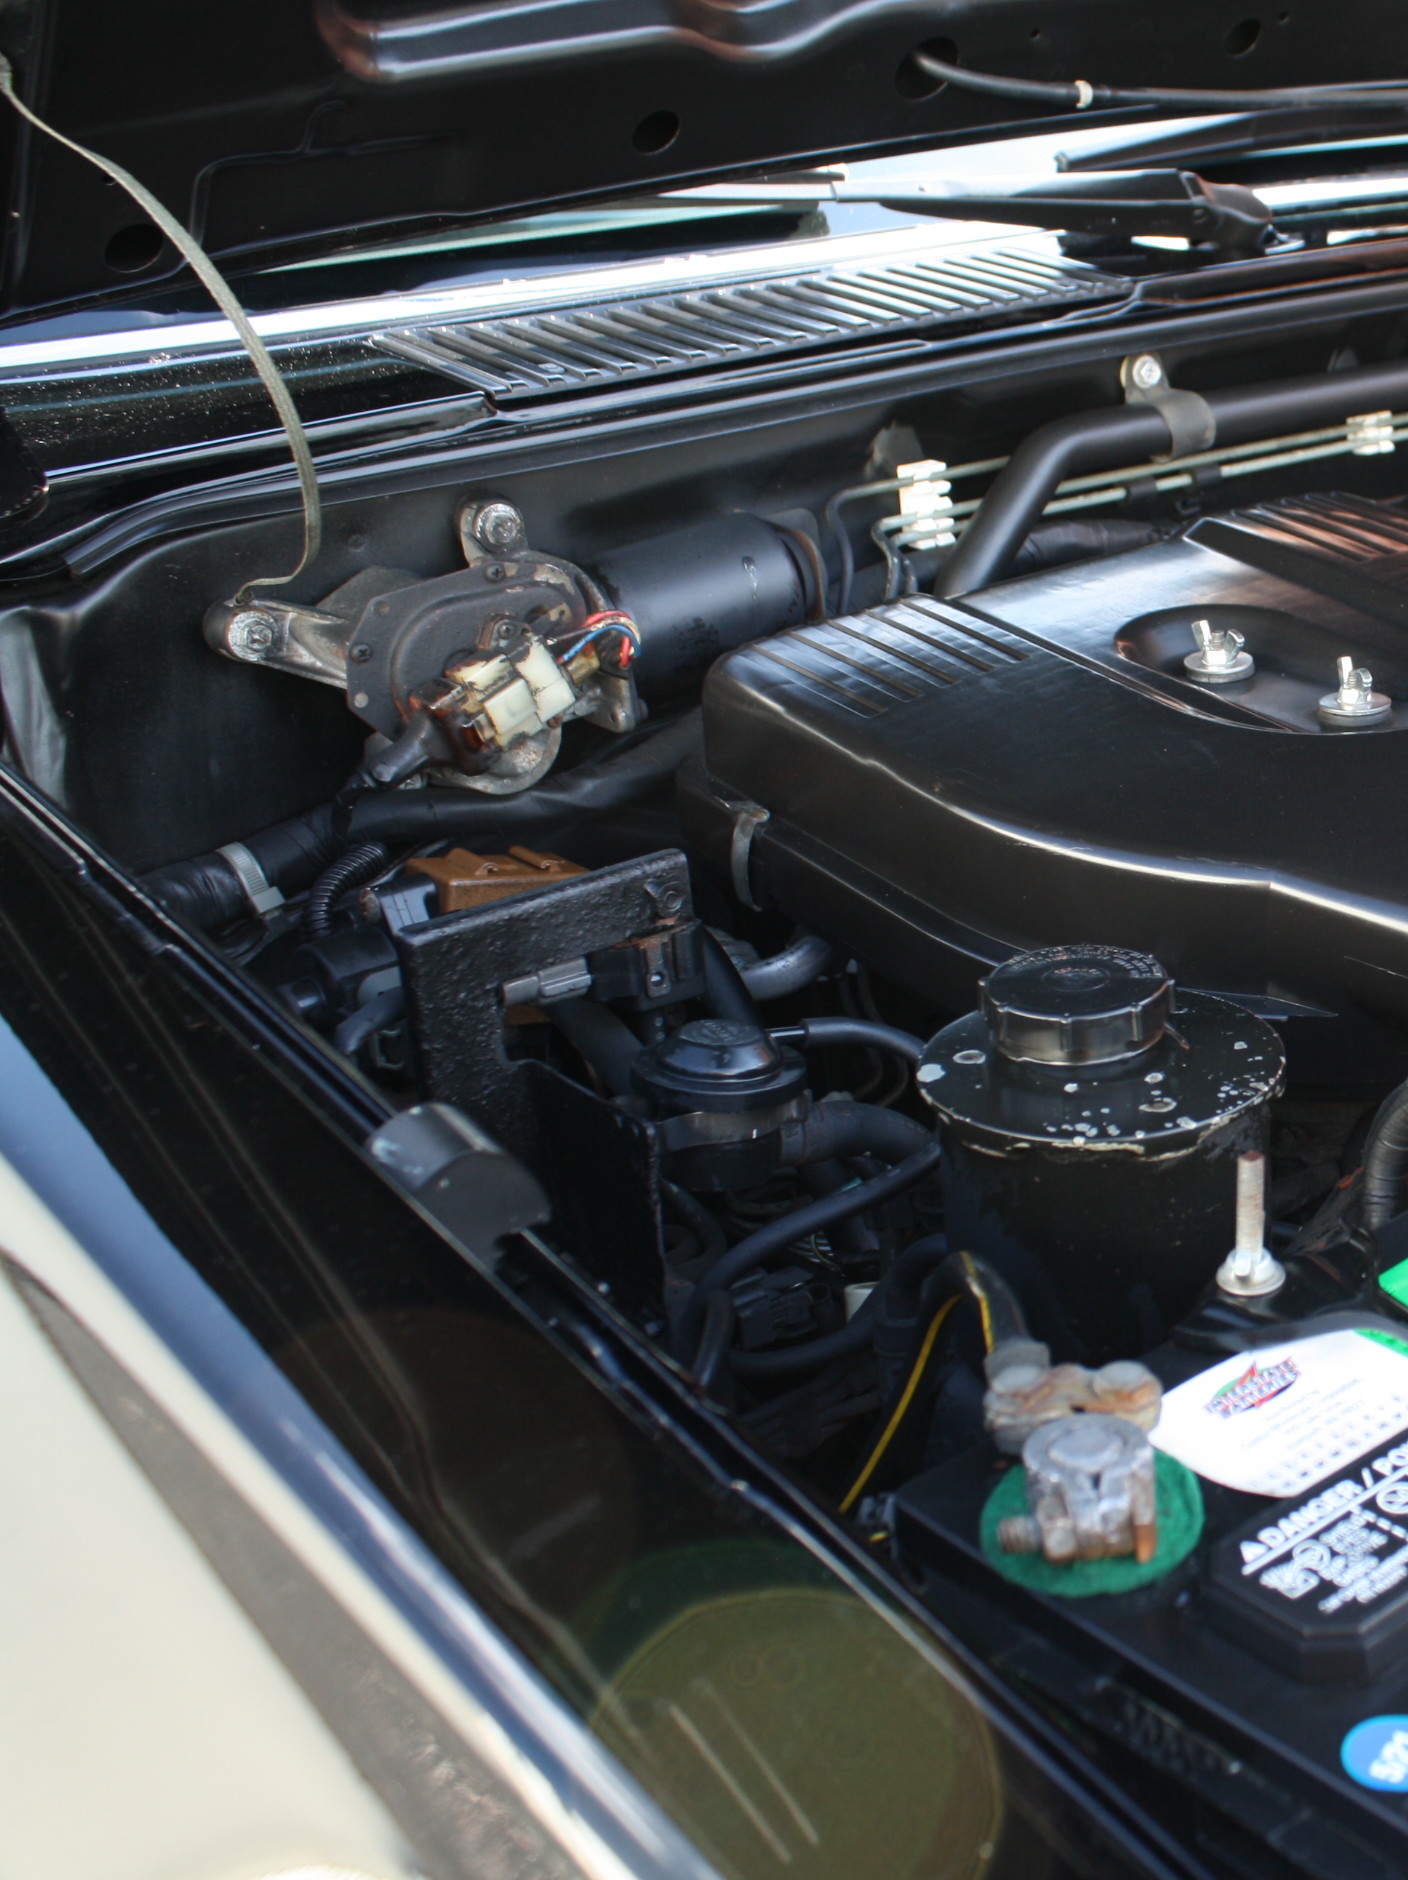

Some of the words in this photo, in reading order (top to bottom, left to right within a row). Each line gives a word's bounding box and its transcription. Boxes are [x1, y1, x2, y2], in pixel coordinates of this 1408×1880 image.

[1204, 1357, 1297, 1414] INTERSTATE
[1219, 1370, 1301, 1420] BATTERIES
[1257, 1479, 1363, 1548] DANGER
